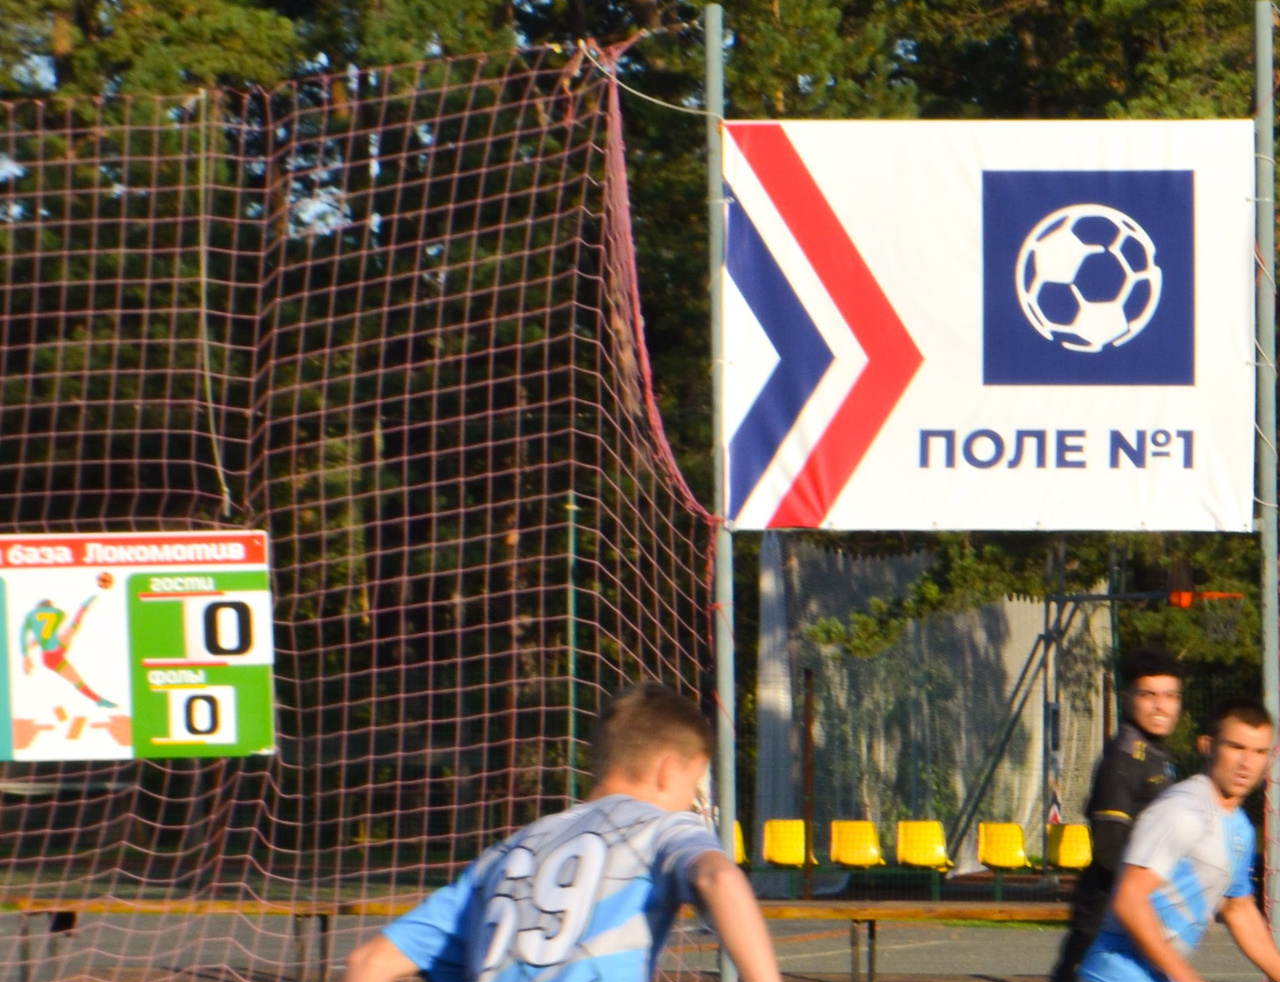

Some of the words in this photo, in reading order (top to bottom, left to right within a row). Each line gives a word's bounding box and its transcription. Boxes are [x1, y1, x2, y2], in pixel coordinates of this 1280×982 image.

[919, 428, 1087, 469] ПОЛЕ
[1109, 428, 1194, 469] №1
[7, 544, 73, 565] база
[83, 542, 246, 563] Локомотив
[203, 601, 255, 656] 0
[184, 694, 220, 736] 0
